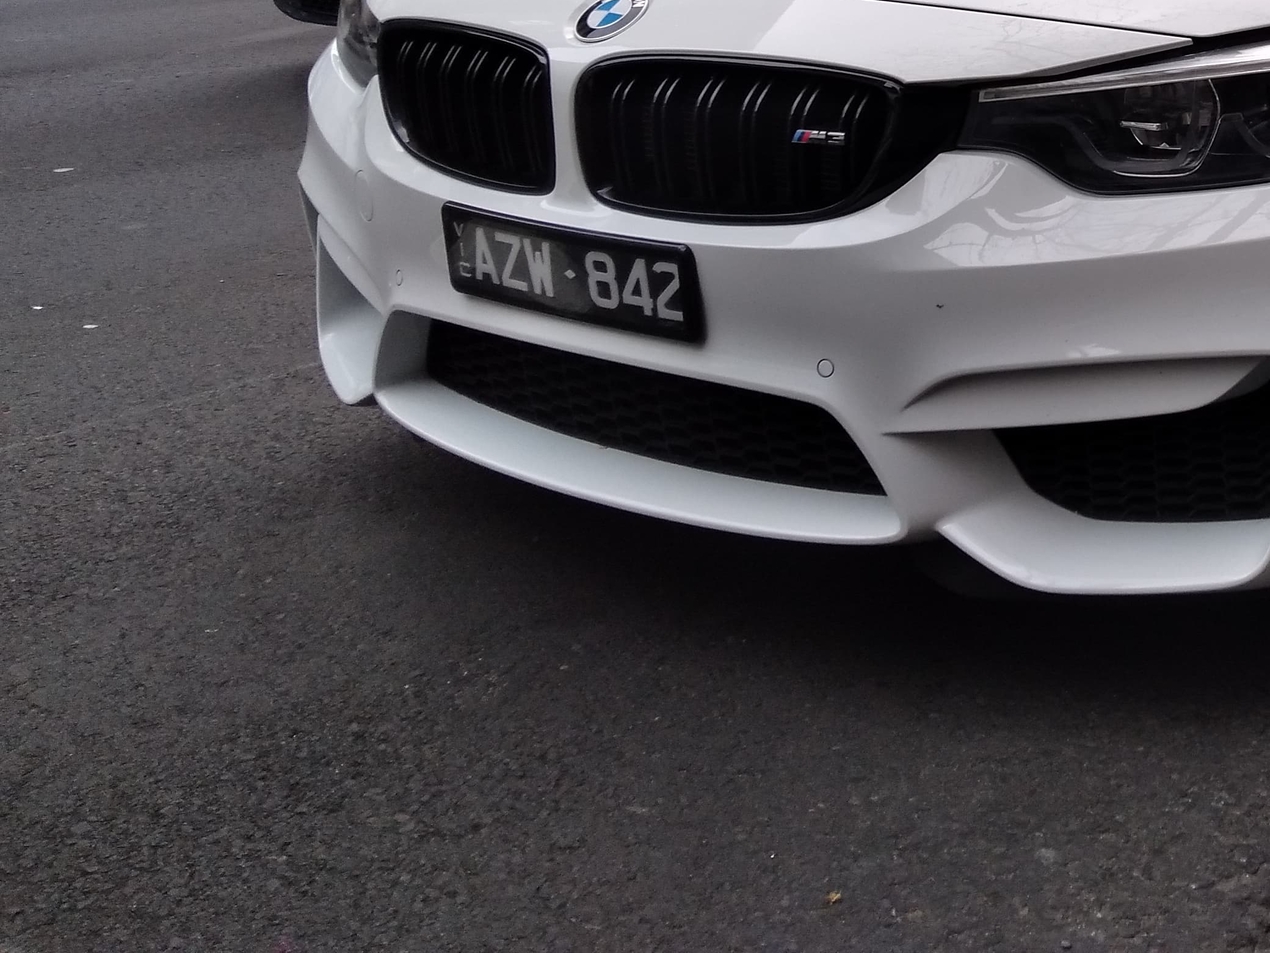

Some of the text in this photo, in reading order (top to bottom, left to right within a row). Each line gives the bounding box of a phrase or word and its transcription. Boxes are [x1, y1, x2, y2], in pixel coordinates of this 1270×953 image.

[792, 129, 846, 145] M3
[453, 221, 472, 278] VIC
[475, 226, 684, 322] AZW 842
